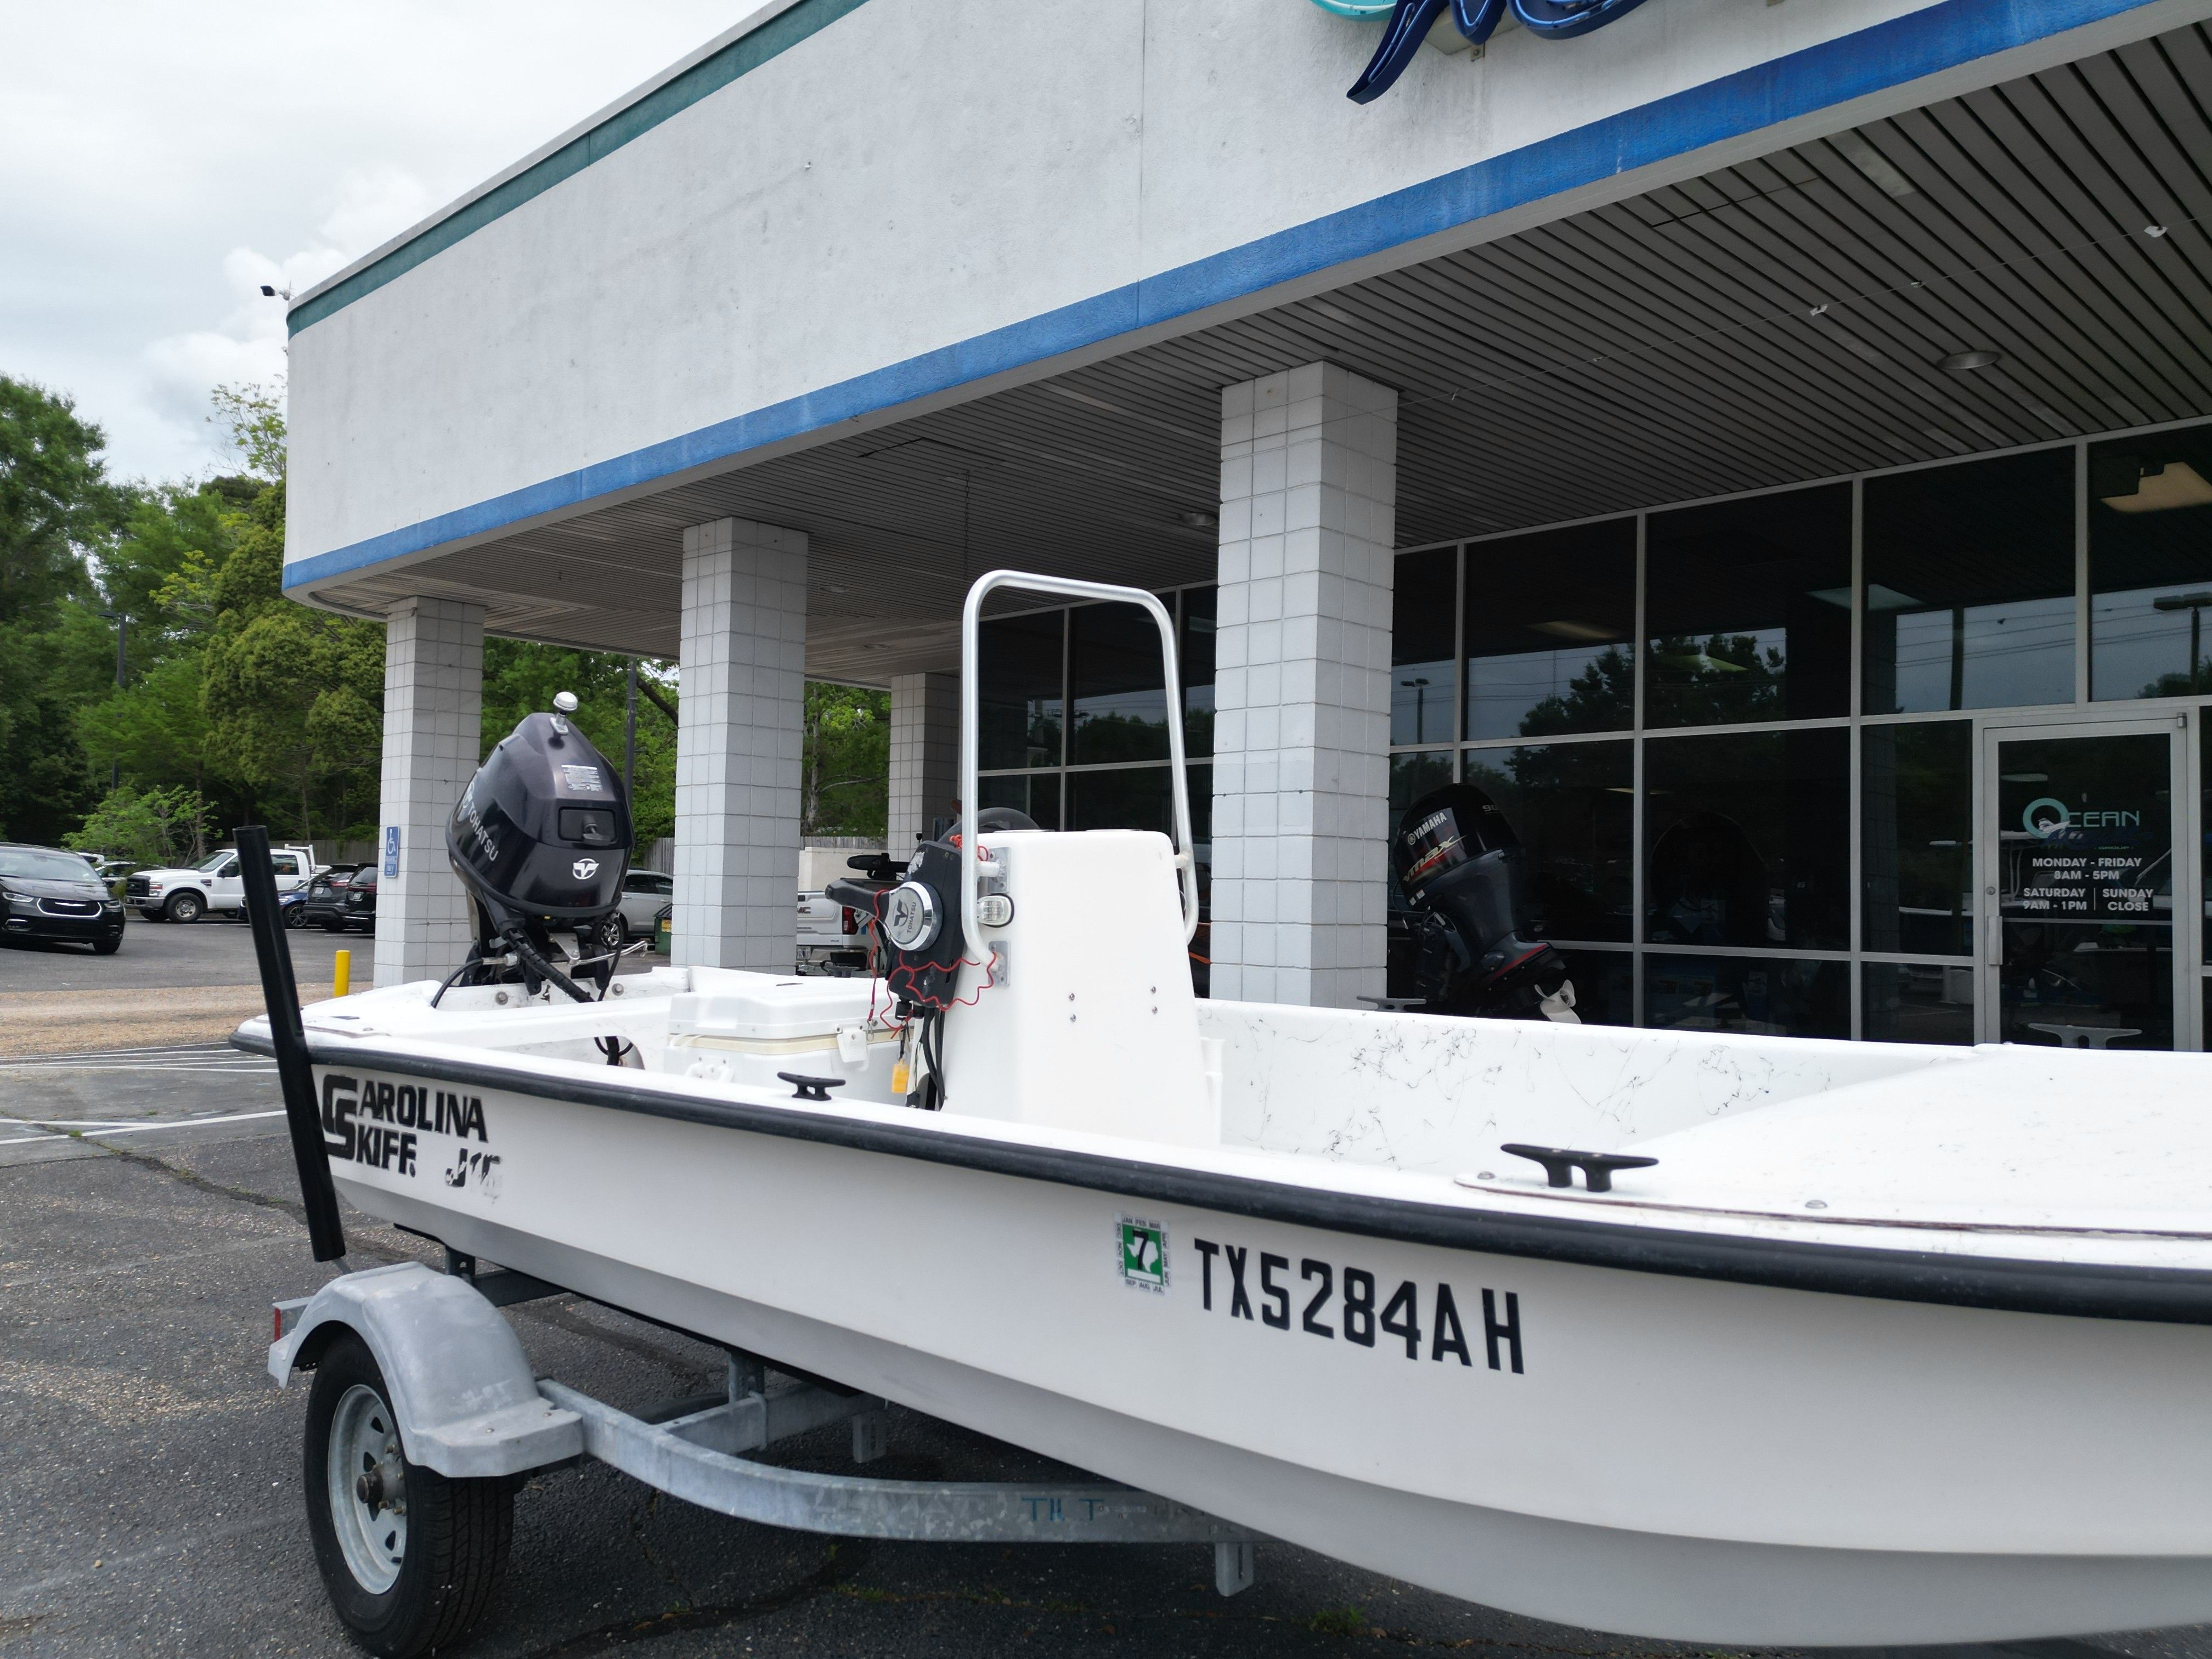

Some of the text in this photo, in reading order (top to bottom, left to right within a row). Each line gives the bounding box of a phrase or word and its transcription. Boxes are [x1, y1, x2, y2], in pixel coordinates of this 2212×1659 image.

[468, 802, 499, 861] TOHATSU
[1414, 812, 1447, 839] YAMAHA
[2023, 798, 2140, 839] OCEAN
[2032, 858, 2087, 867] MONDAY
[2098, 857, 2142, 867] FRIDAY
[2054, 871, 2081, 879] 8AM
[2092, 871, 2119, 879] 5PM
[2023, 888, 2086, 897] SATURDAY
[2023, 901, 2050, 910] 9AM
[2061, 901, 2087, 910] 1PM
[2102, 888, 2153, 898] SUNDAY
[2107, 901, 2149, 911] CLOSE
[907, 901, 917, 933] TOHATSU
[323, 1074, 488, 1143] CAROLINA
[326, 1098, 417, 1175] SKIFF
[1132, 1229, 1149, 1270] 7
[1194, 1238, 1525, 1375] TX5284AH
